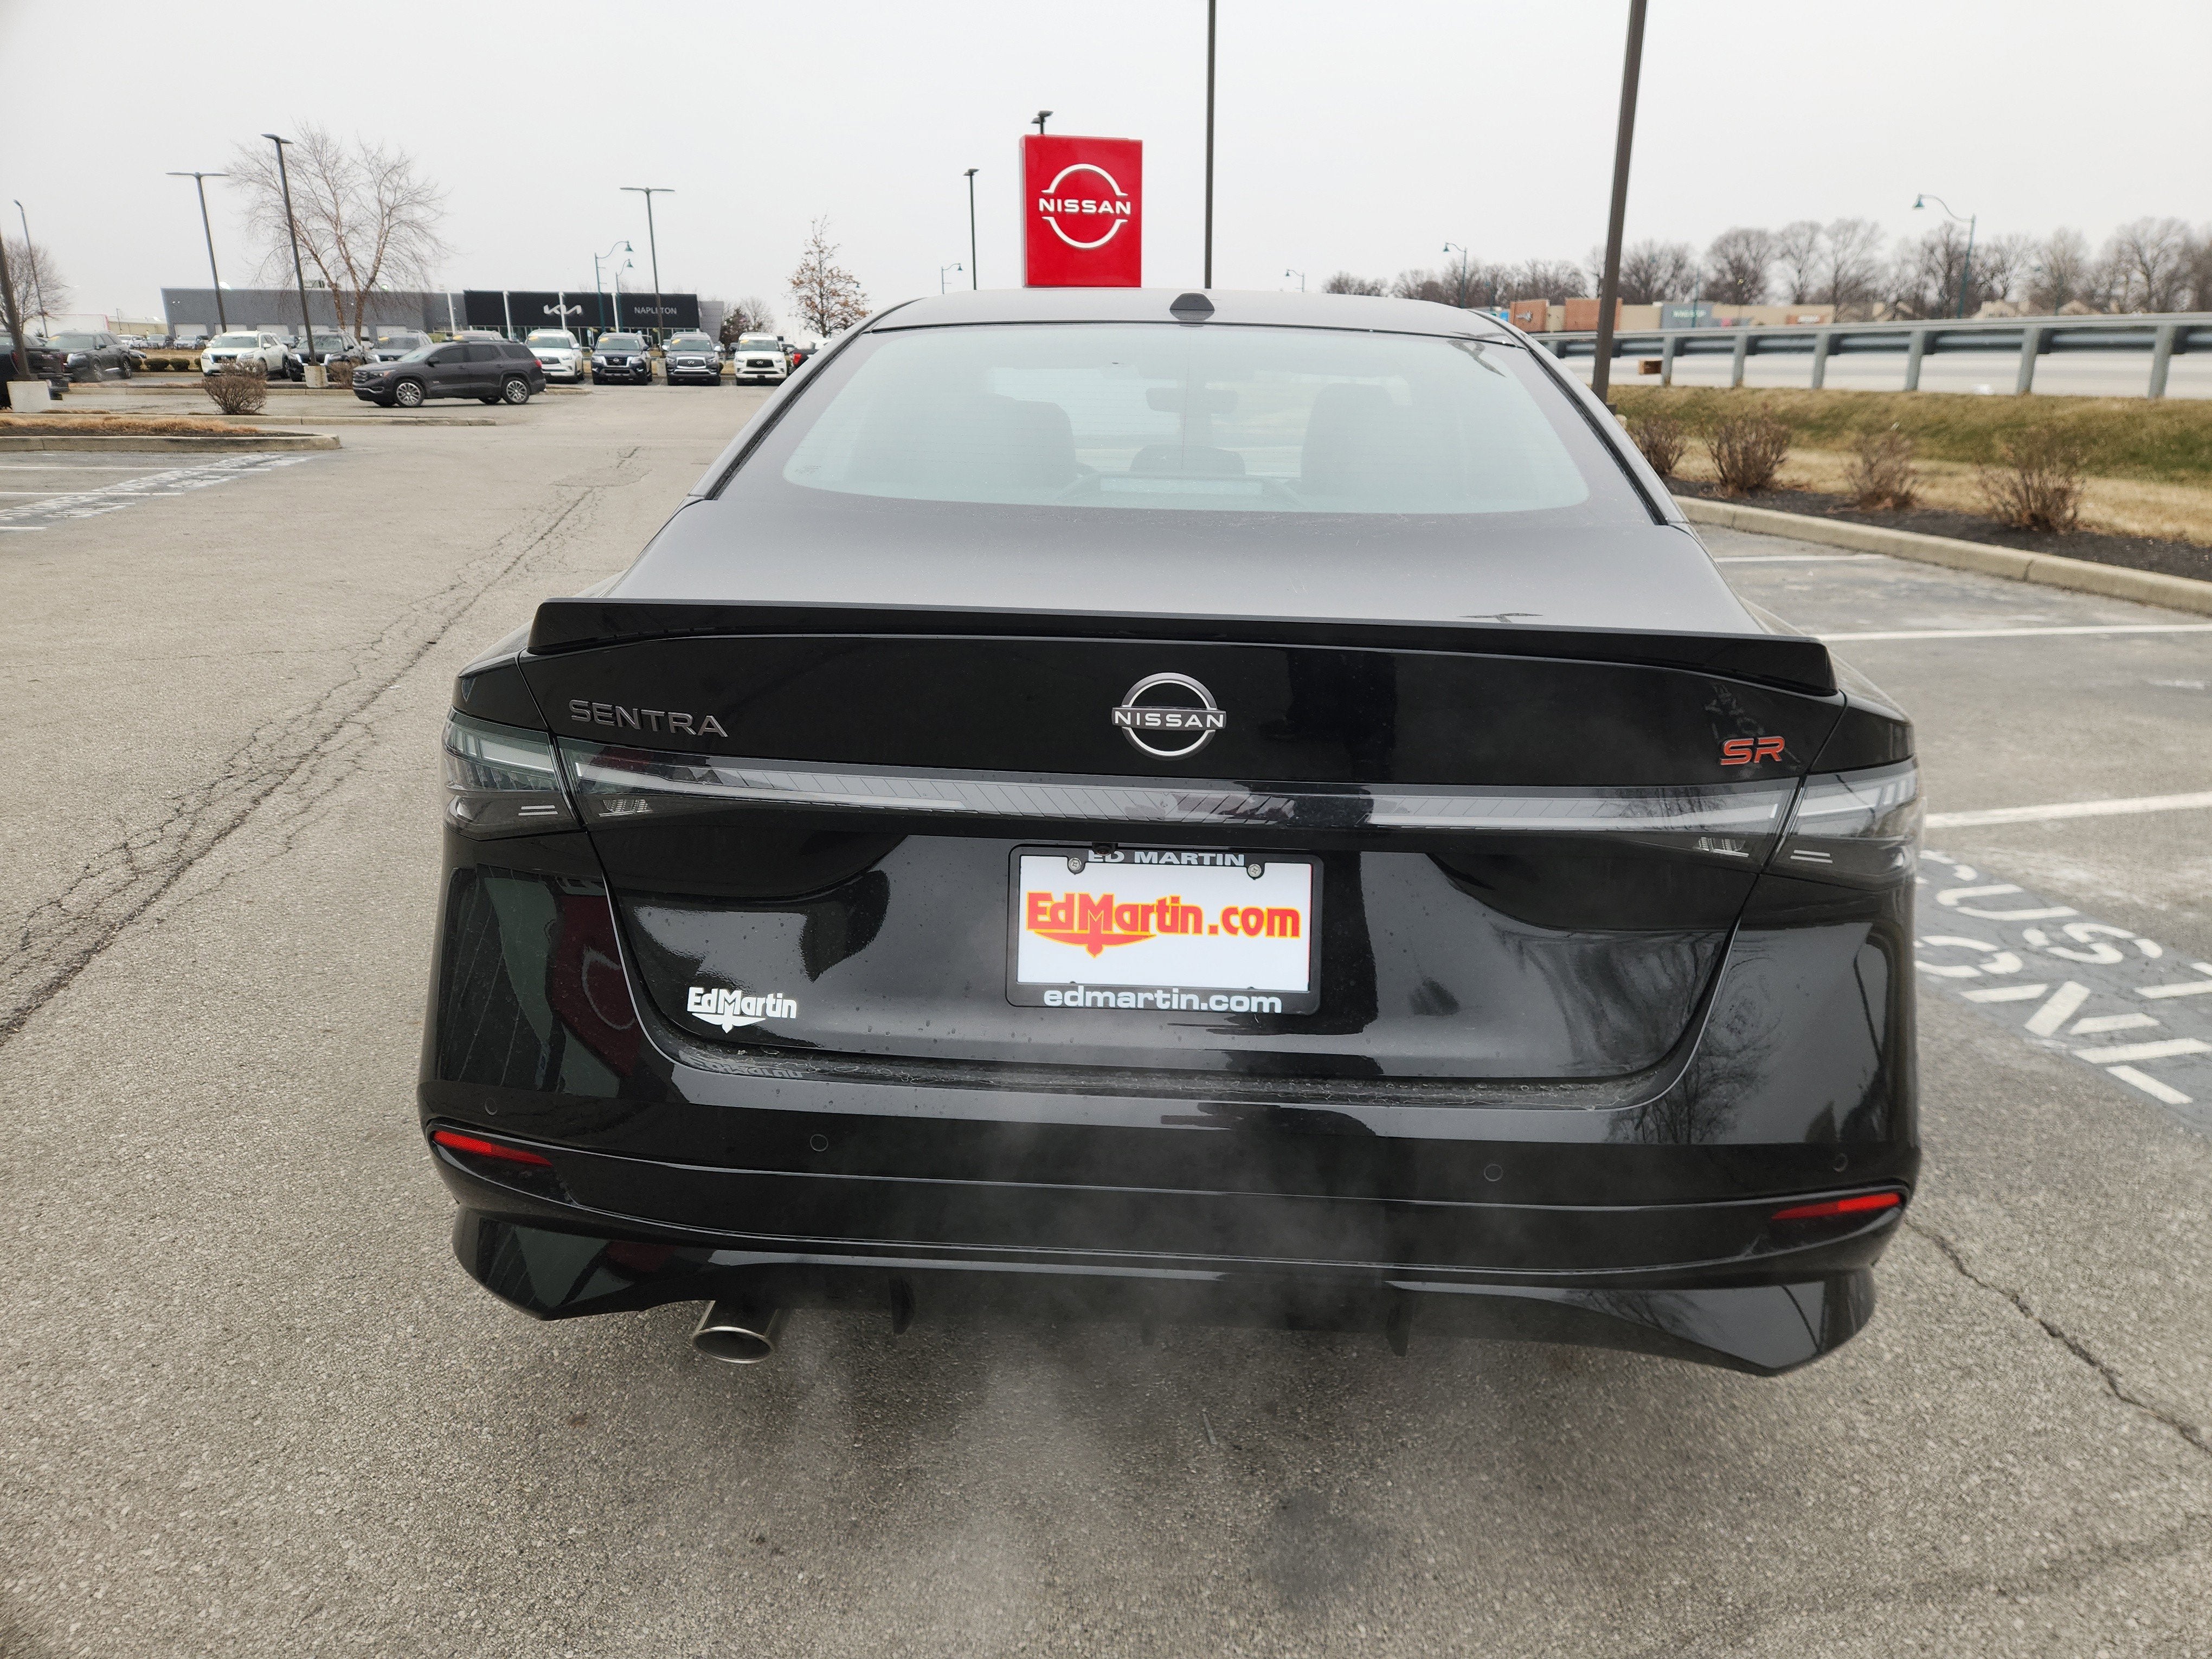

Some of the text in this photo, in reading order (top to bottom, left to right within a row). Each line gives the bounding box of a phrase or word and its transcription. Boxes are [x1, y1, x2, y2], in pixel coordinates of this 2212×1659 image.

[1038, 198, 1131, 214] NISSAN
[634, 306, 677, 314] NAPLTON
[569, 699, 729, 738] SENTRA
[1115, 711, 1224, 728] NISSAN
[1720, 736, 1785, 766] SR
[1088, 850, 1245, 866] ED MARTIN
[1026, 891, 1301, 938] EdMartin.com
[687, 987, 797, 1019] EdMartin
[1044, 986, 1282, 1013] edmartin.com
